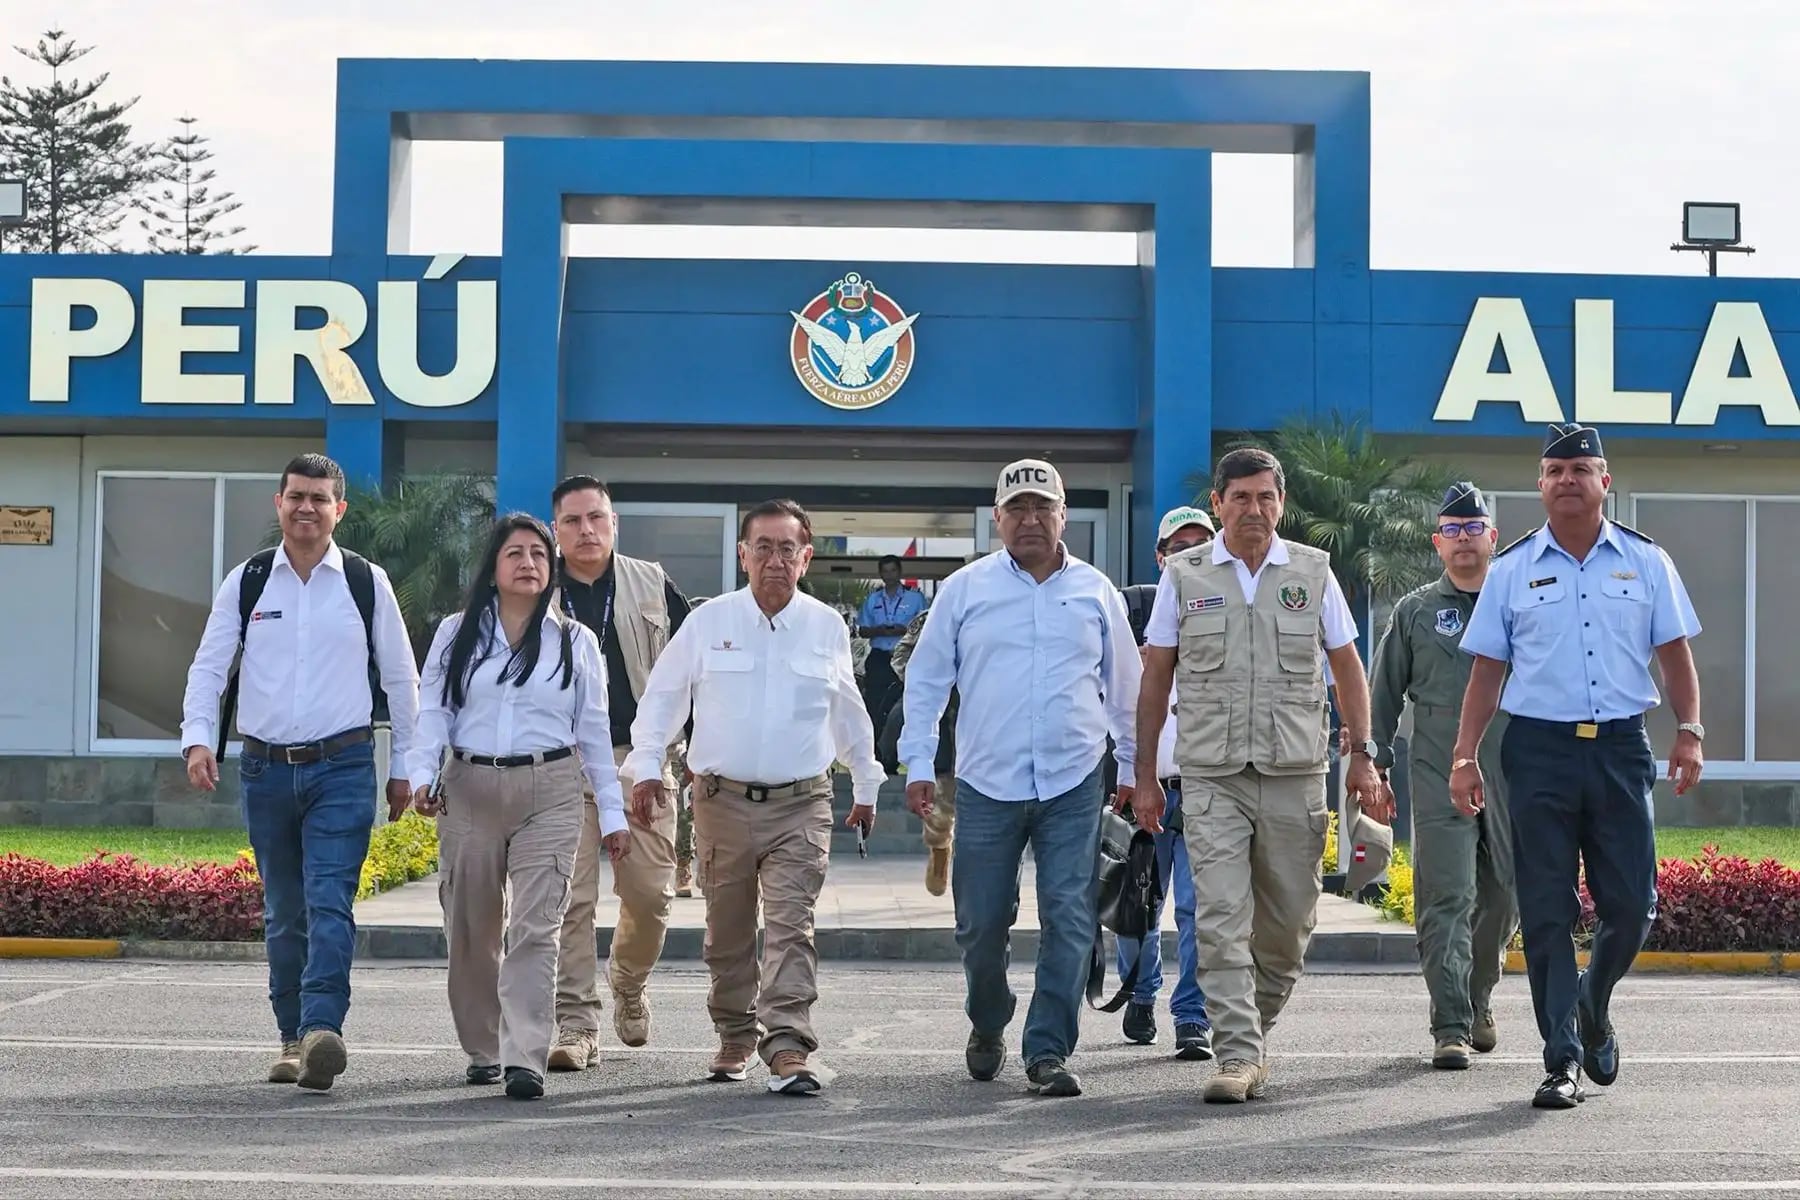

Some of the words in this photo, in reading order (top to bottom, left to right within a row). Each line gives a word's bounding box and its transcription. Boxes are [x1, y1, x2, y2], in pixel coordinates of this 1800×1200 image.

[29, 253, 498, 408] PERÚ
[1432, 297, 1800, 426] ALA
[798, 357, 828, 396] FUERZA
[828, 389, 866, 403] AÉREA
[867, 386, 889, 400] DEL
[886, 359, 907, 387] PERÚ
[1005, 467, 1048, 488] MTC
